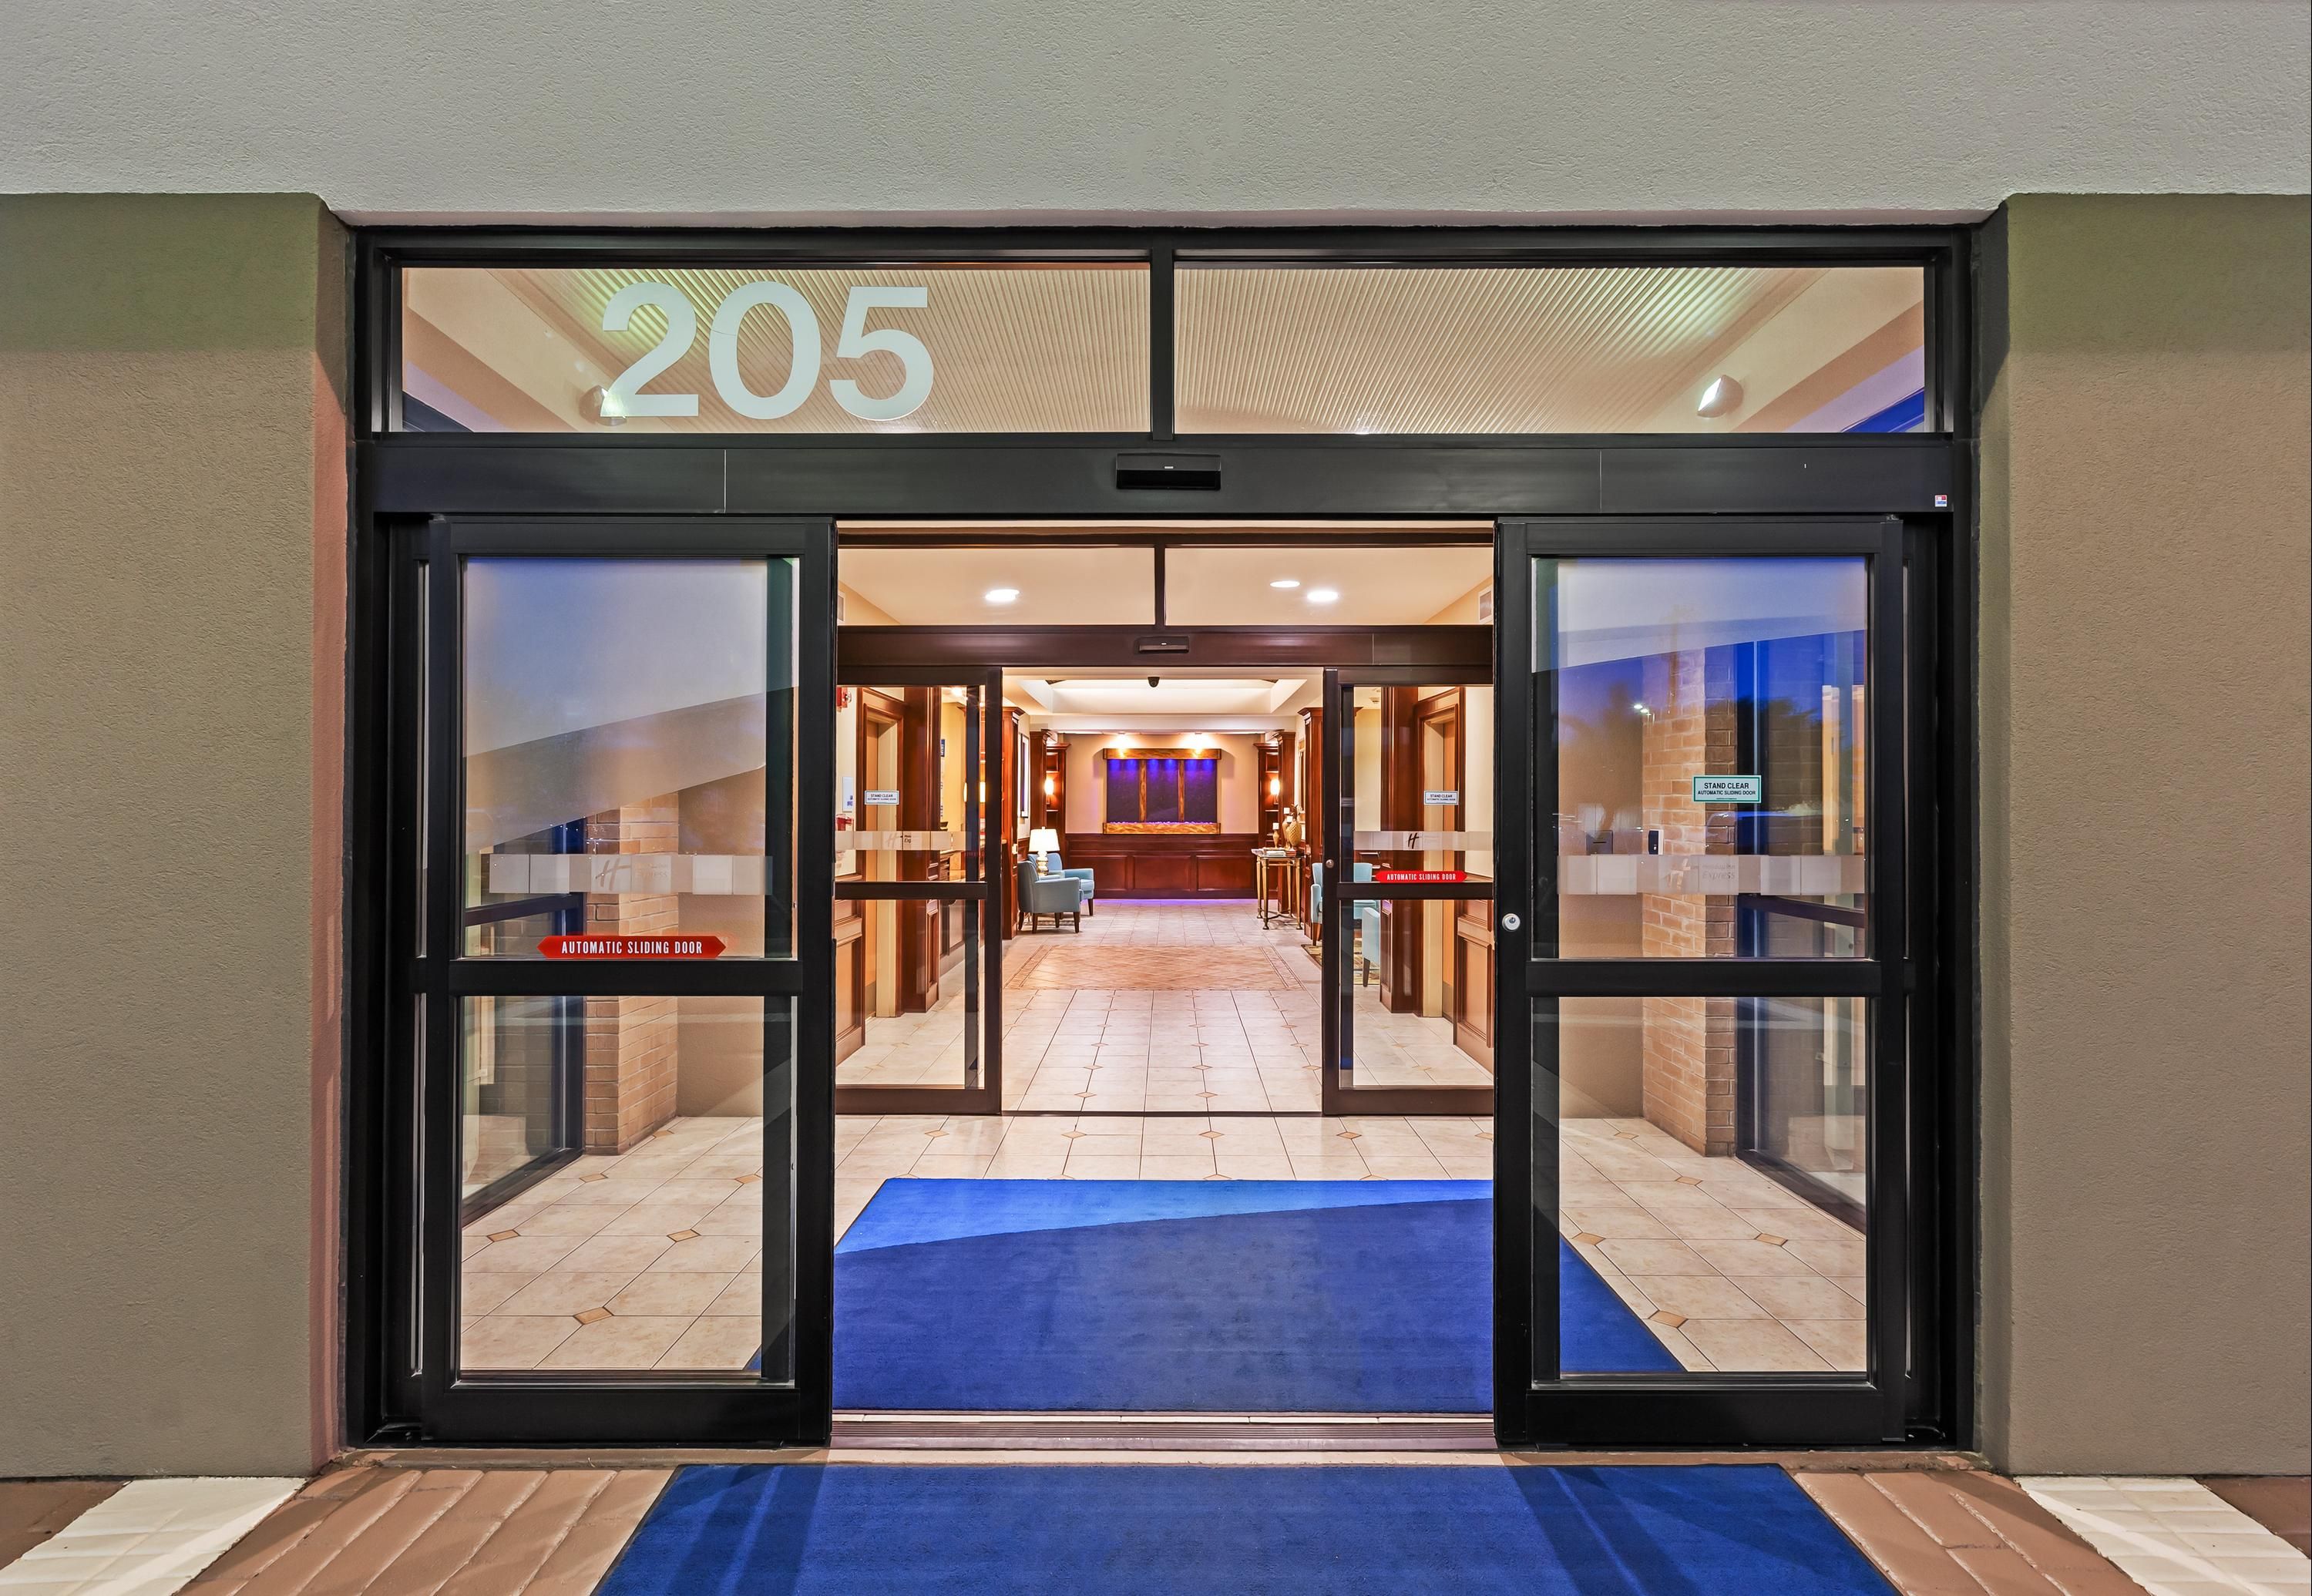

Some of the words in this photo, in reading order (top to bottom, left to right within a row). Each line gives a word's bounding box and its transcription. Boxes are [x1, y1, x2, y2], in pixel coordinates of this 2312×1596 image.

[600, 281, 934, 422] 205
[561, 941, 622, 954] AUTOMATIC
[627, 941, 669, 954] SLIDING
[674, 941, 702, 954] DOOR
